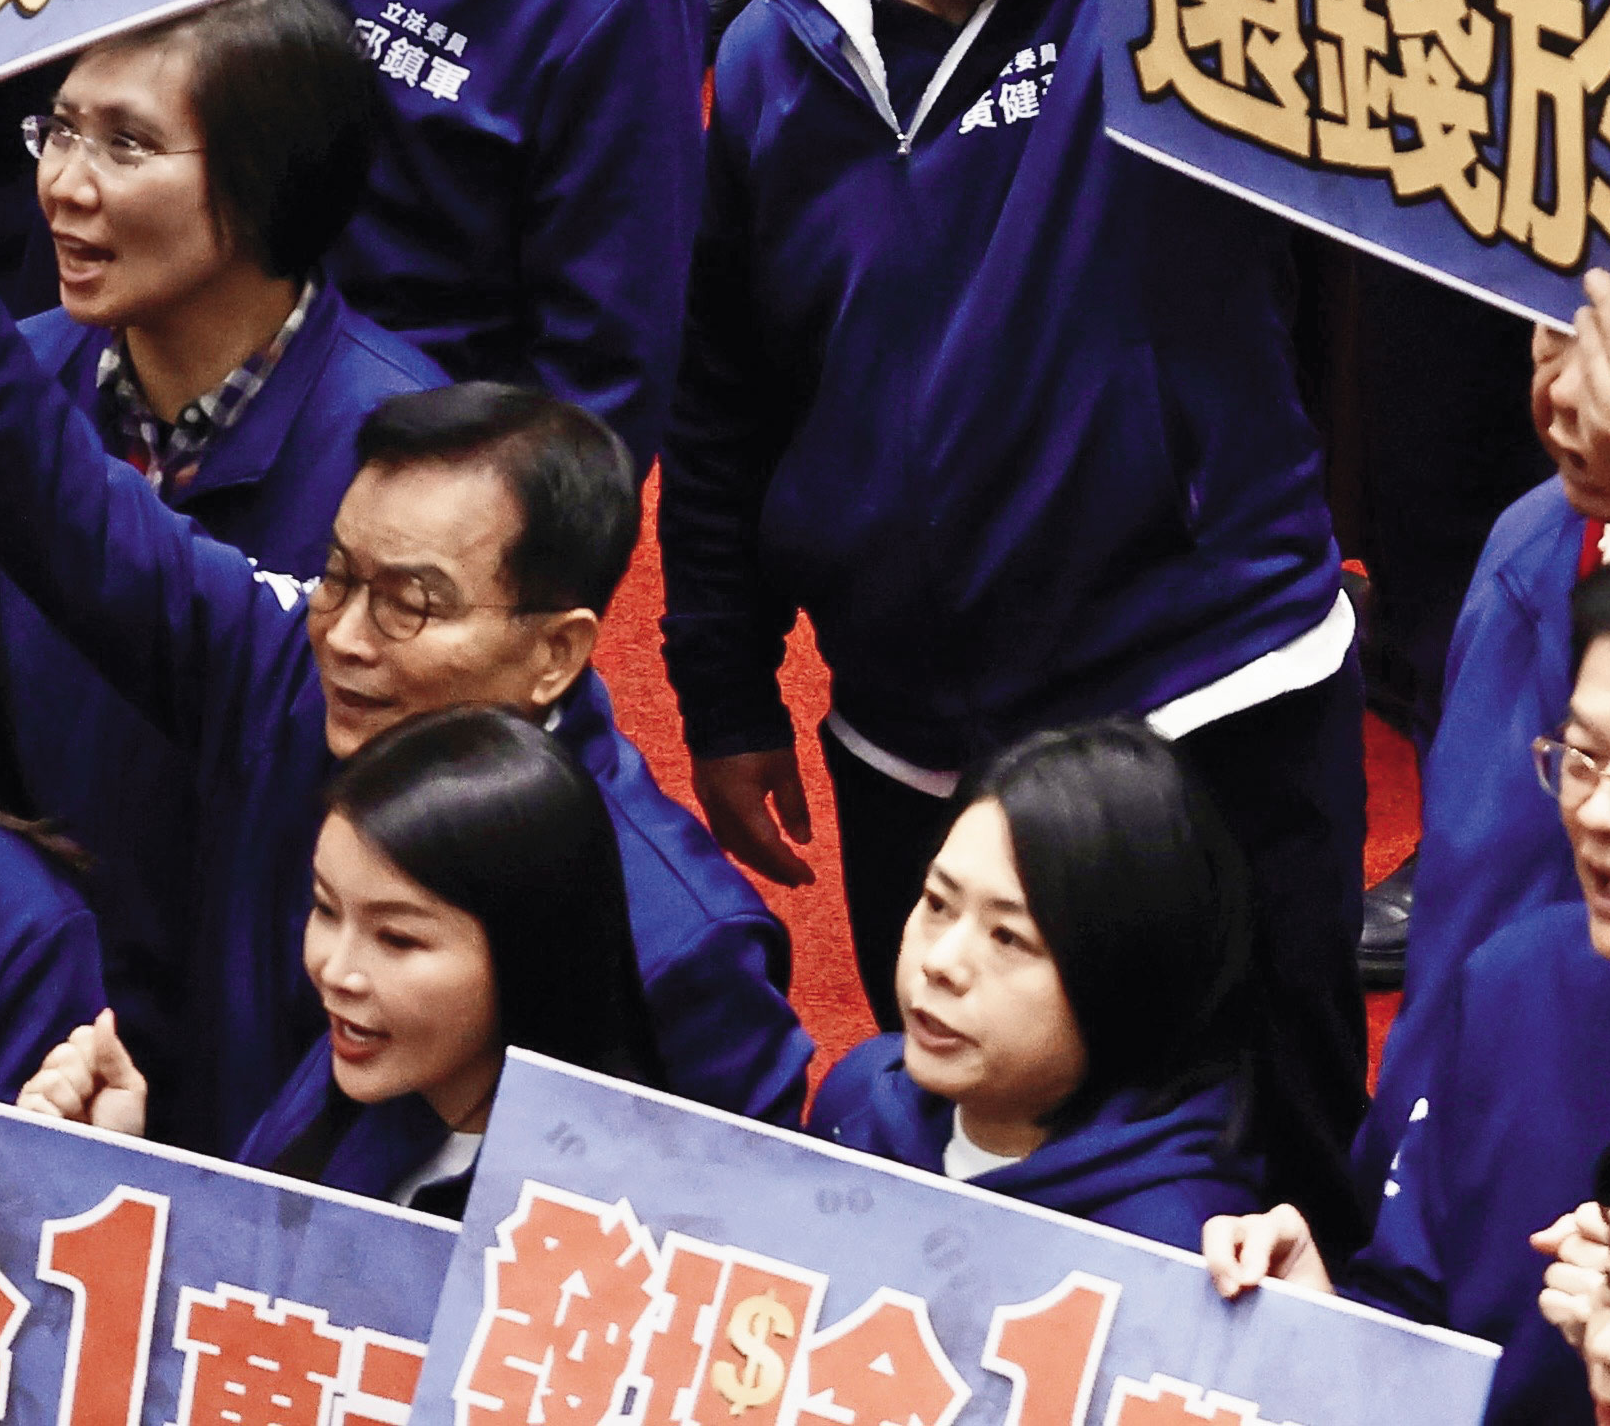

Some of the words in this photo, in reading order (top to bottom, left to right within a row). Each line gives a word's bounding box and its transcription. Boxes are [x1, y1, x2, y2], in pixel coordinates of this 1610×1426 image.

[380, 2, 468, 57] 立法委員
[958, 73, 1054, 134] 黃健
